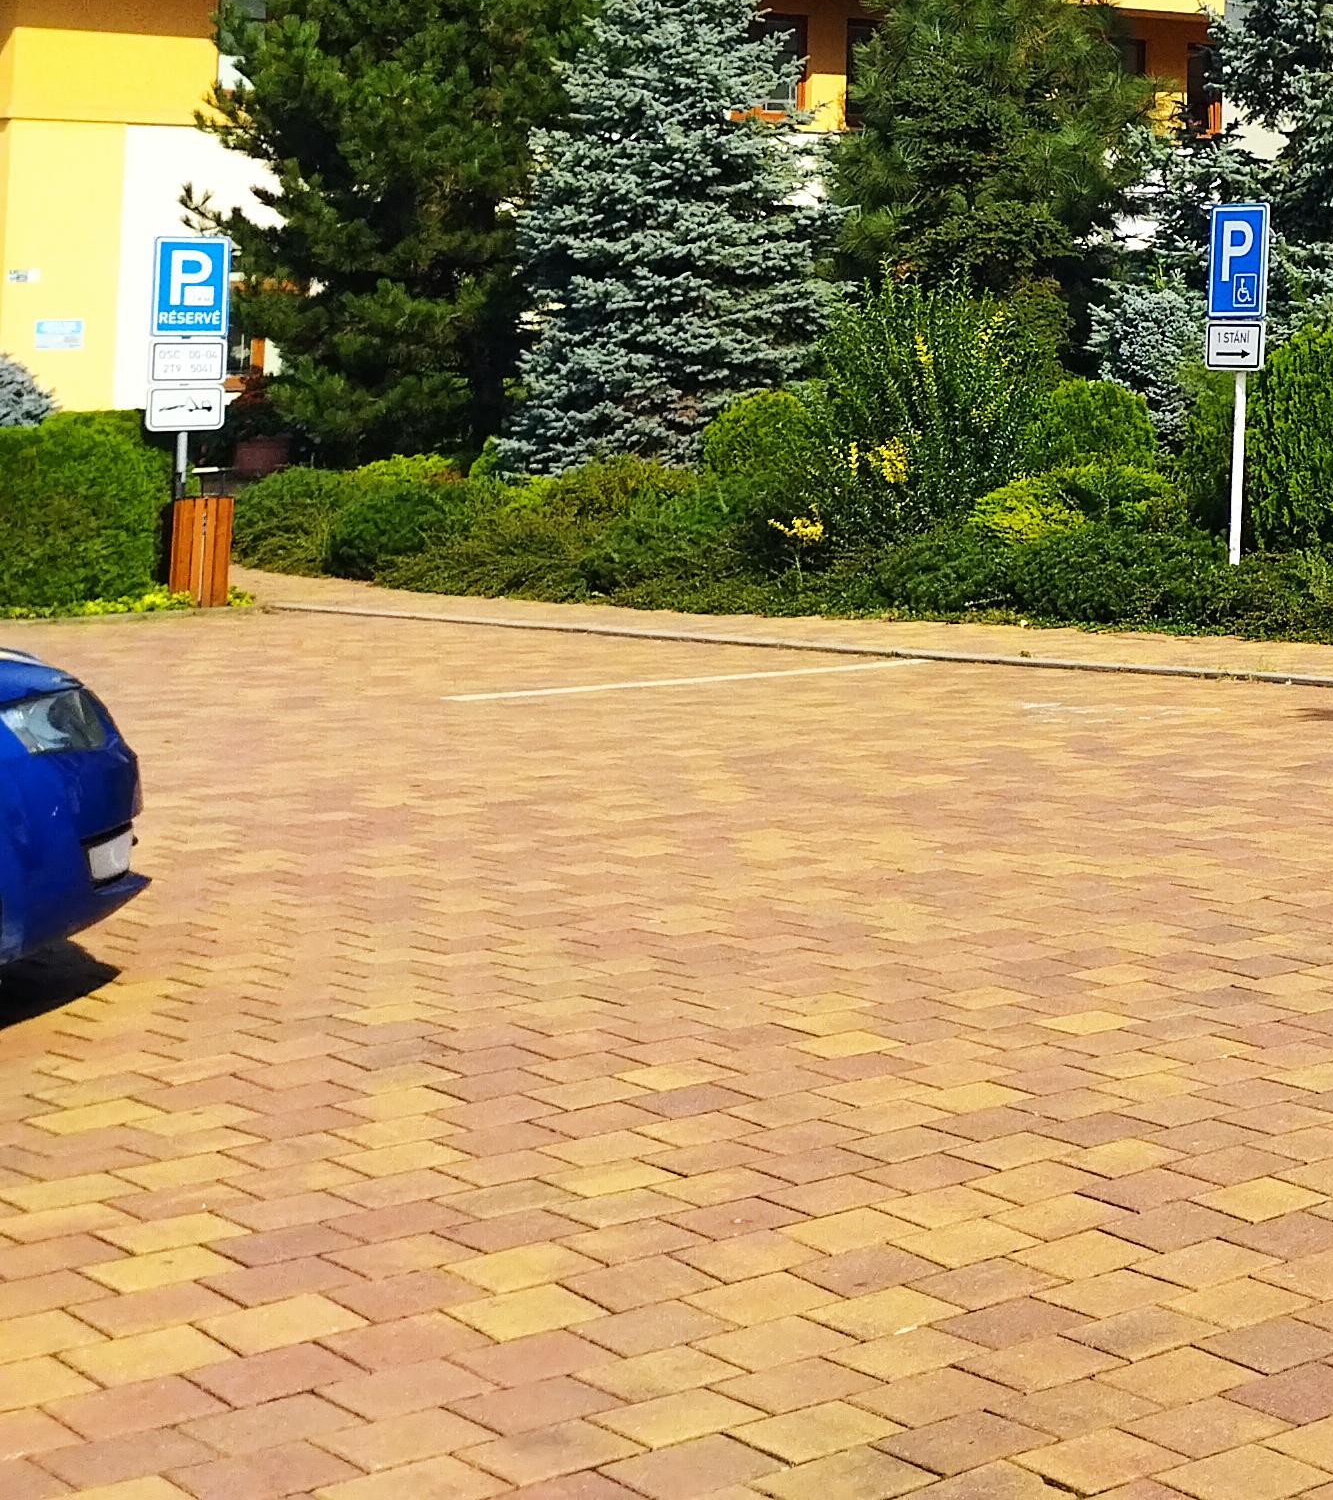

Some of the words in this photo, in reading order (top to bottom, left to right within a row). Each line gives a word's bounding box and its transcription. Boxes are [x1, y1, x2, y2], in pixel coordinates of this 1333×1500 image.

[1221, 220, 1254, 282] P
[169, 249, 213, 306] P
[159, 310, 221, 325] RÉSERVÉ
[1217, 332, 1222, 343] 1
[1224, 330, 1250, 344] STÁNÍ
